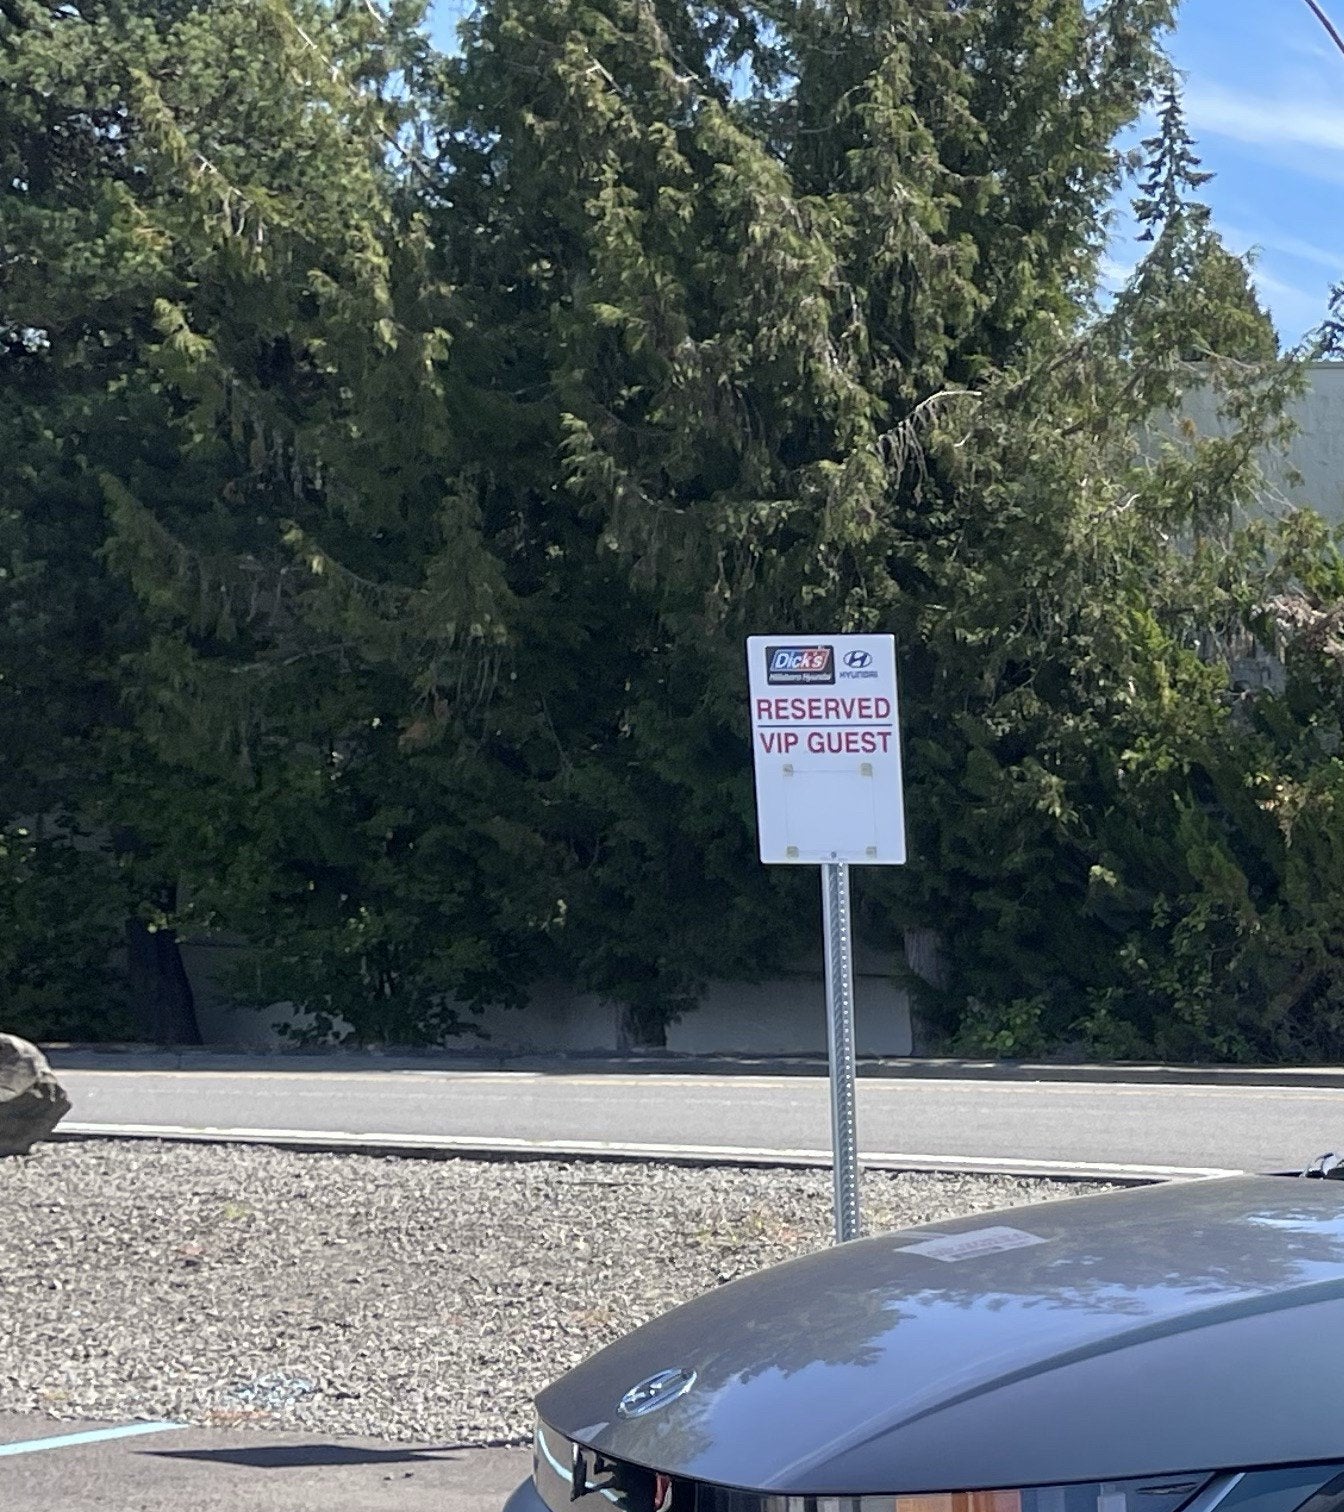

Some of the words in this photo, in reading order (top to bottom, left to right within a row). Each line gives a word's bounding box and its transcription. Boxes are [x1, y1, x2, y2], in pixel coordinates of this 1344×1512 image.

[774, 650, 824, 669] Dick's
[756, 698, 891, 720] RESERVED
[760, 732, 799, 754] VIP
[807, 731, 892, 754] GUEST
